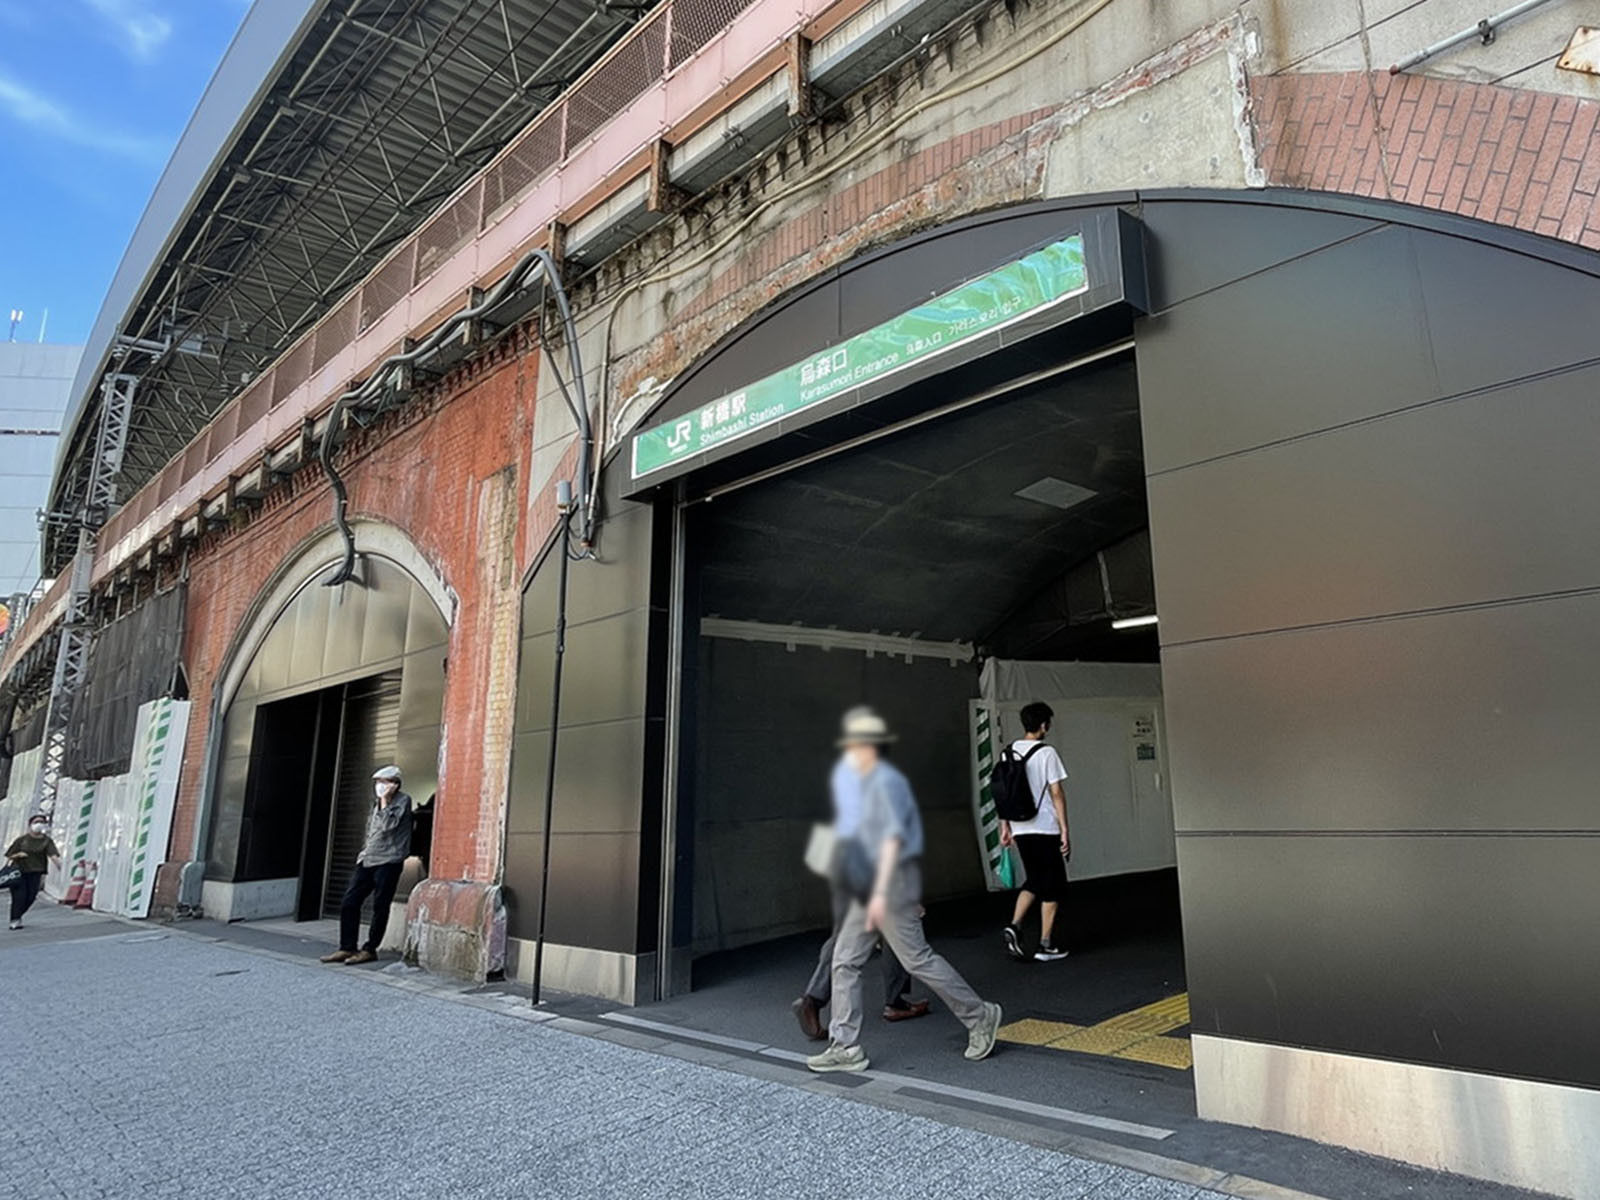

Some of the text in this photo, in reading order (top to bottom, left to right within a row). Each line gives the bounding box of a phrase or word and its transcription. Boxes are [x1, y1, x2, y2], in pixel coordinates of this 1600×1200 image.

[801, 348, 848, 387] 烏森口
[801, 352, 899, 402] Karasumori Entrance
[700, 403, 785, 447] Shimbashi Station
[701, 392, 747, 431] 新橋駅
[667, 419, 692, 448] JR
